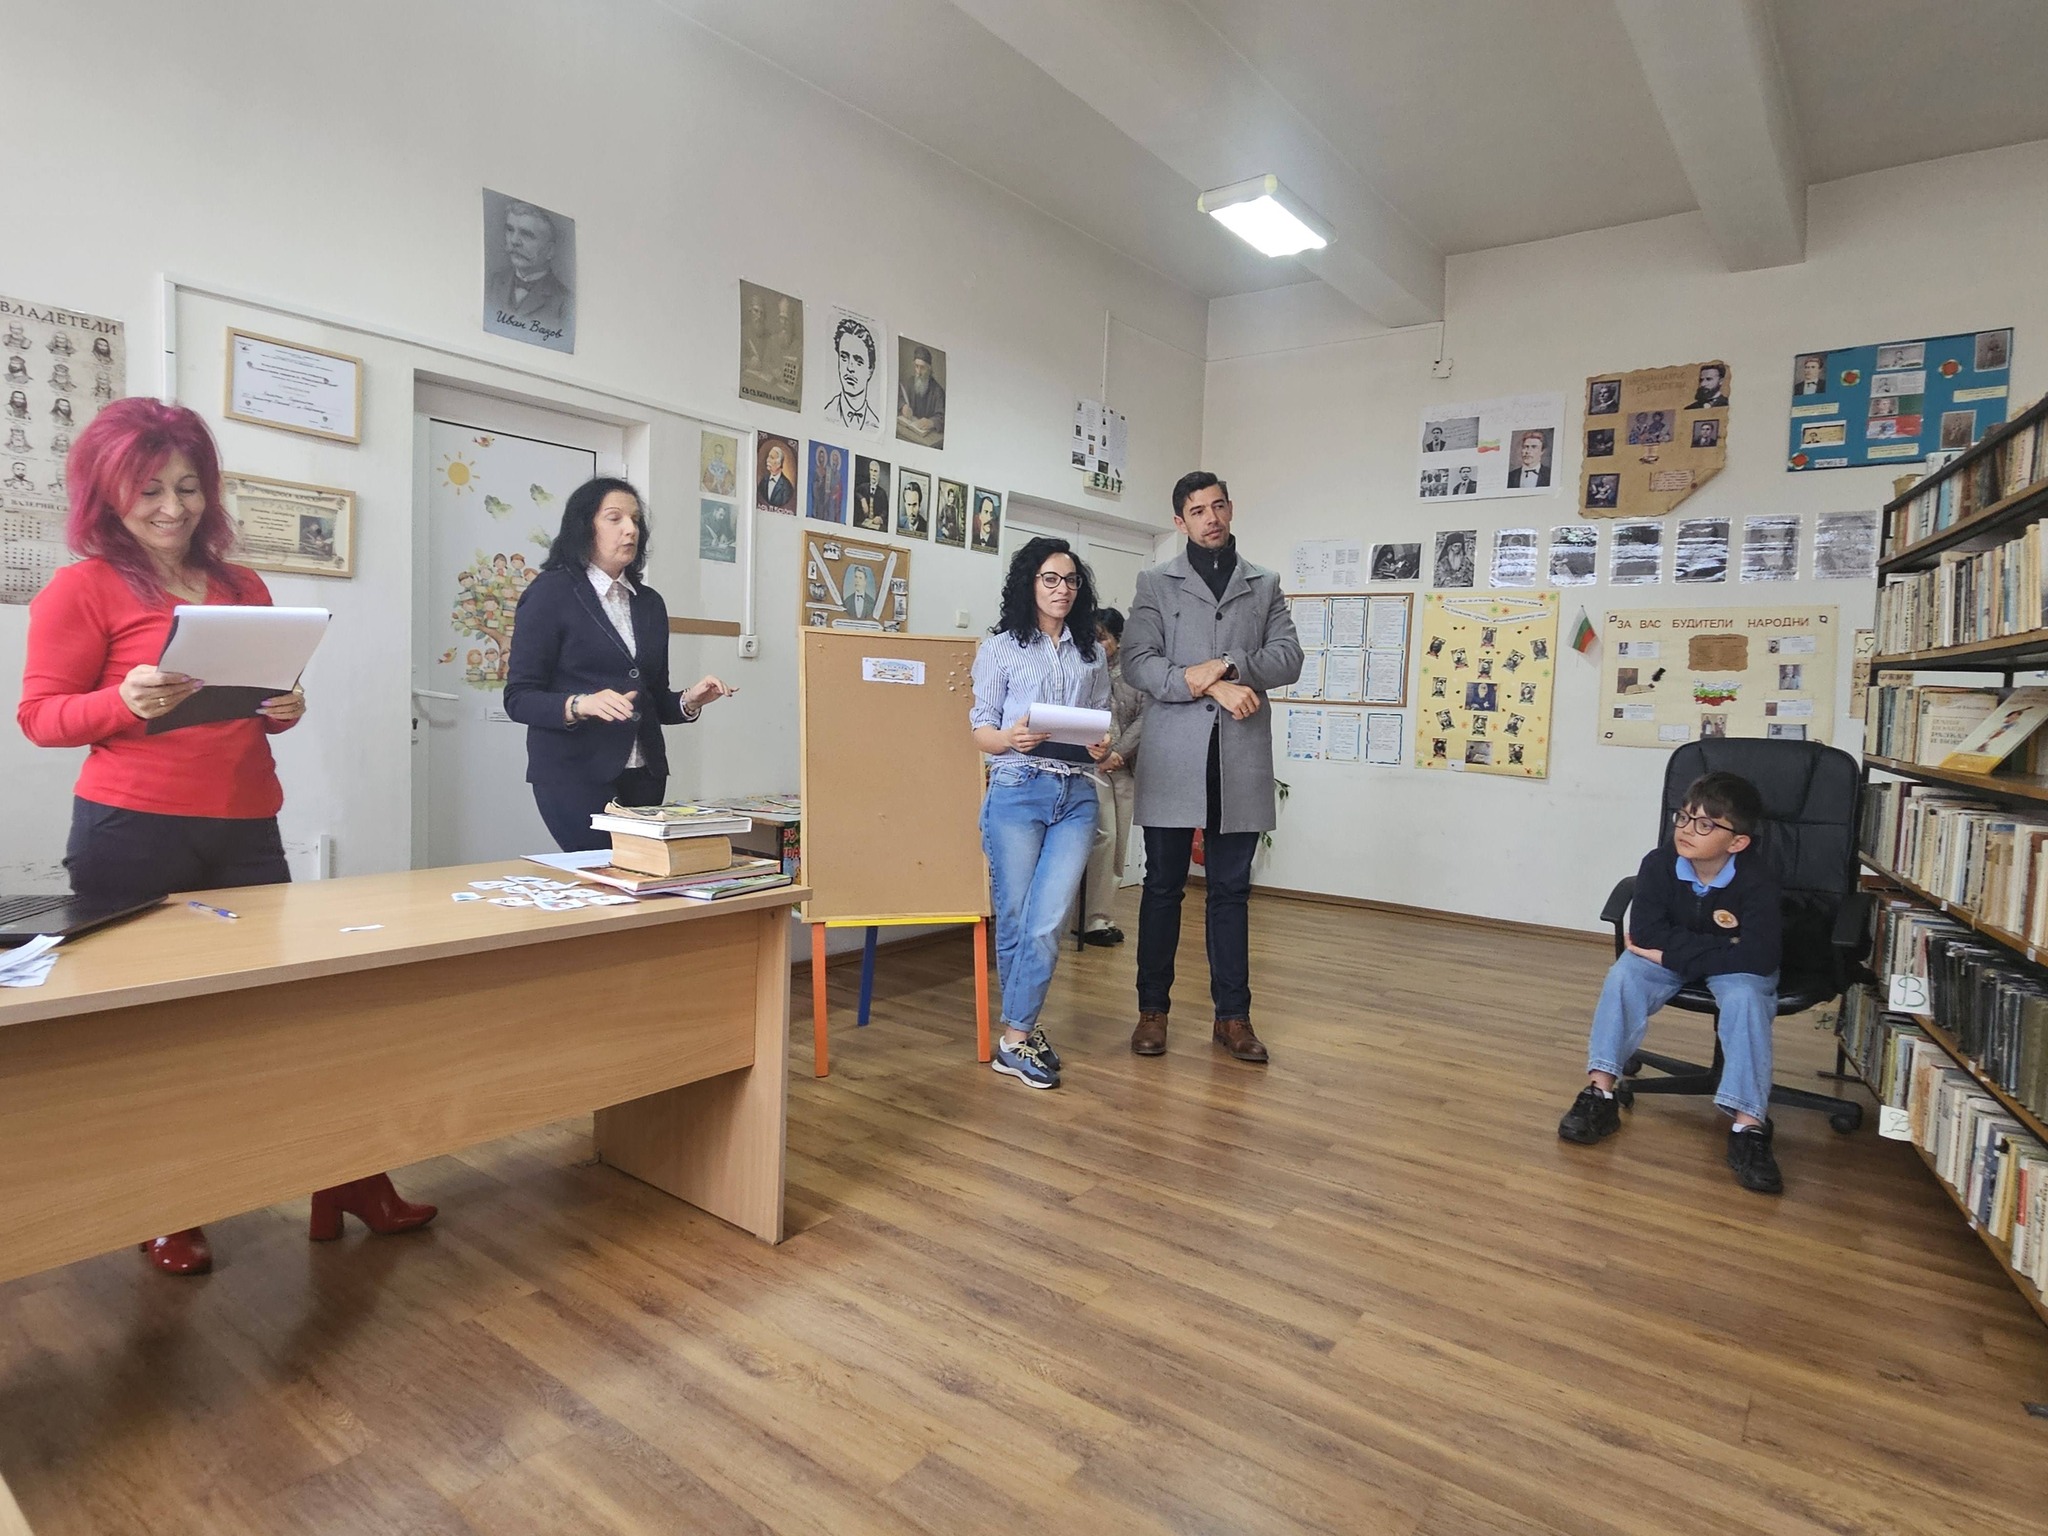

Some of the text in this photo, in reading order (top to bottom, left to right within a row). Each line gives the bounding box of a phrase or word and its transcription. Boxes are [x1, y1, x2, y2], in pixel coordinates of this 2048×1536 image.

[0, 300, 117, 335] ВЛАДЕТЕЛИ
[496, 310, 527, 329] Иван
[1093, 472, 1123, 493] EXIT
[1617, 617, 1809, 629] ЗА ВАС БУДИТЕЛИ НАРОДНИ
